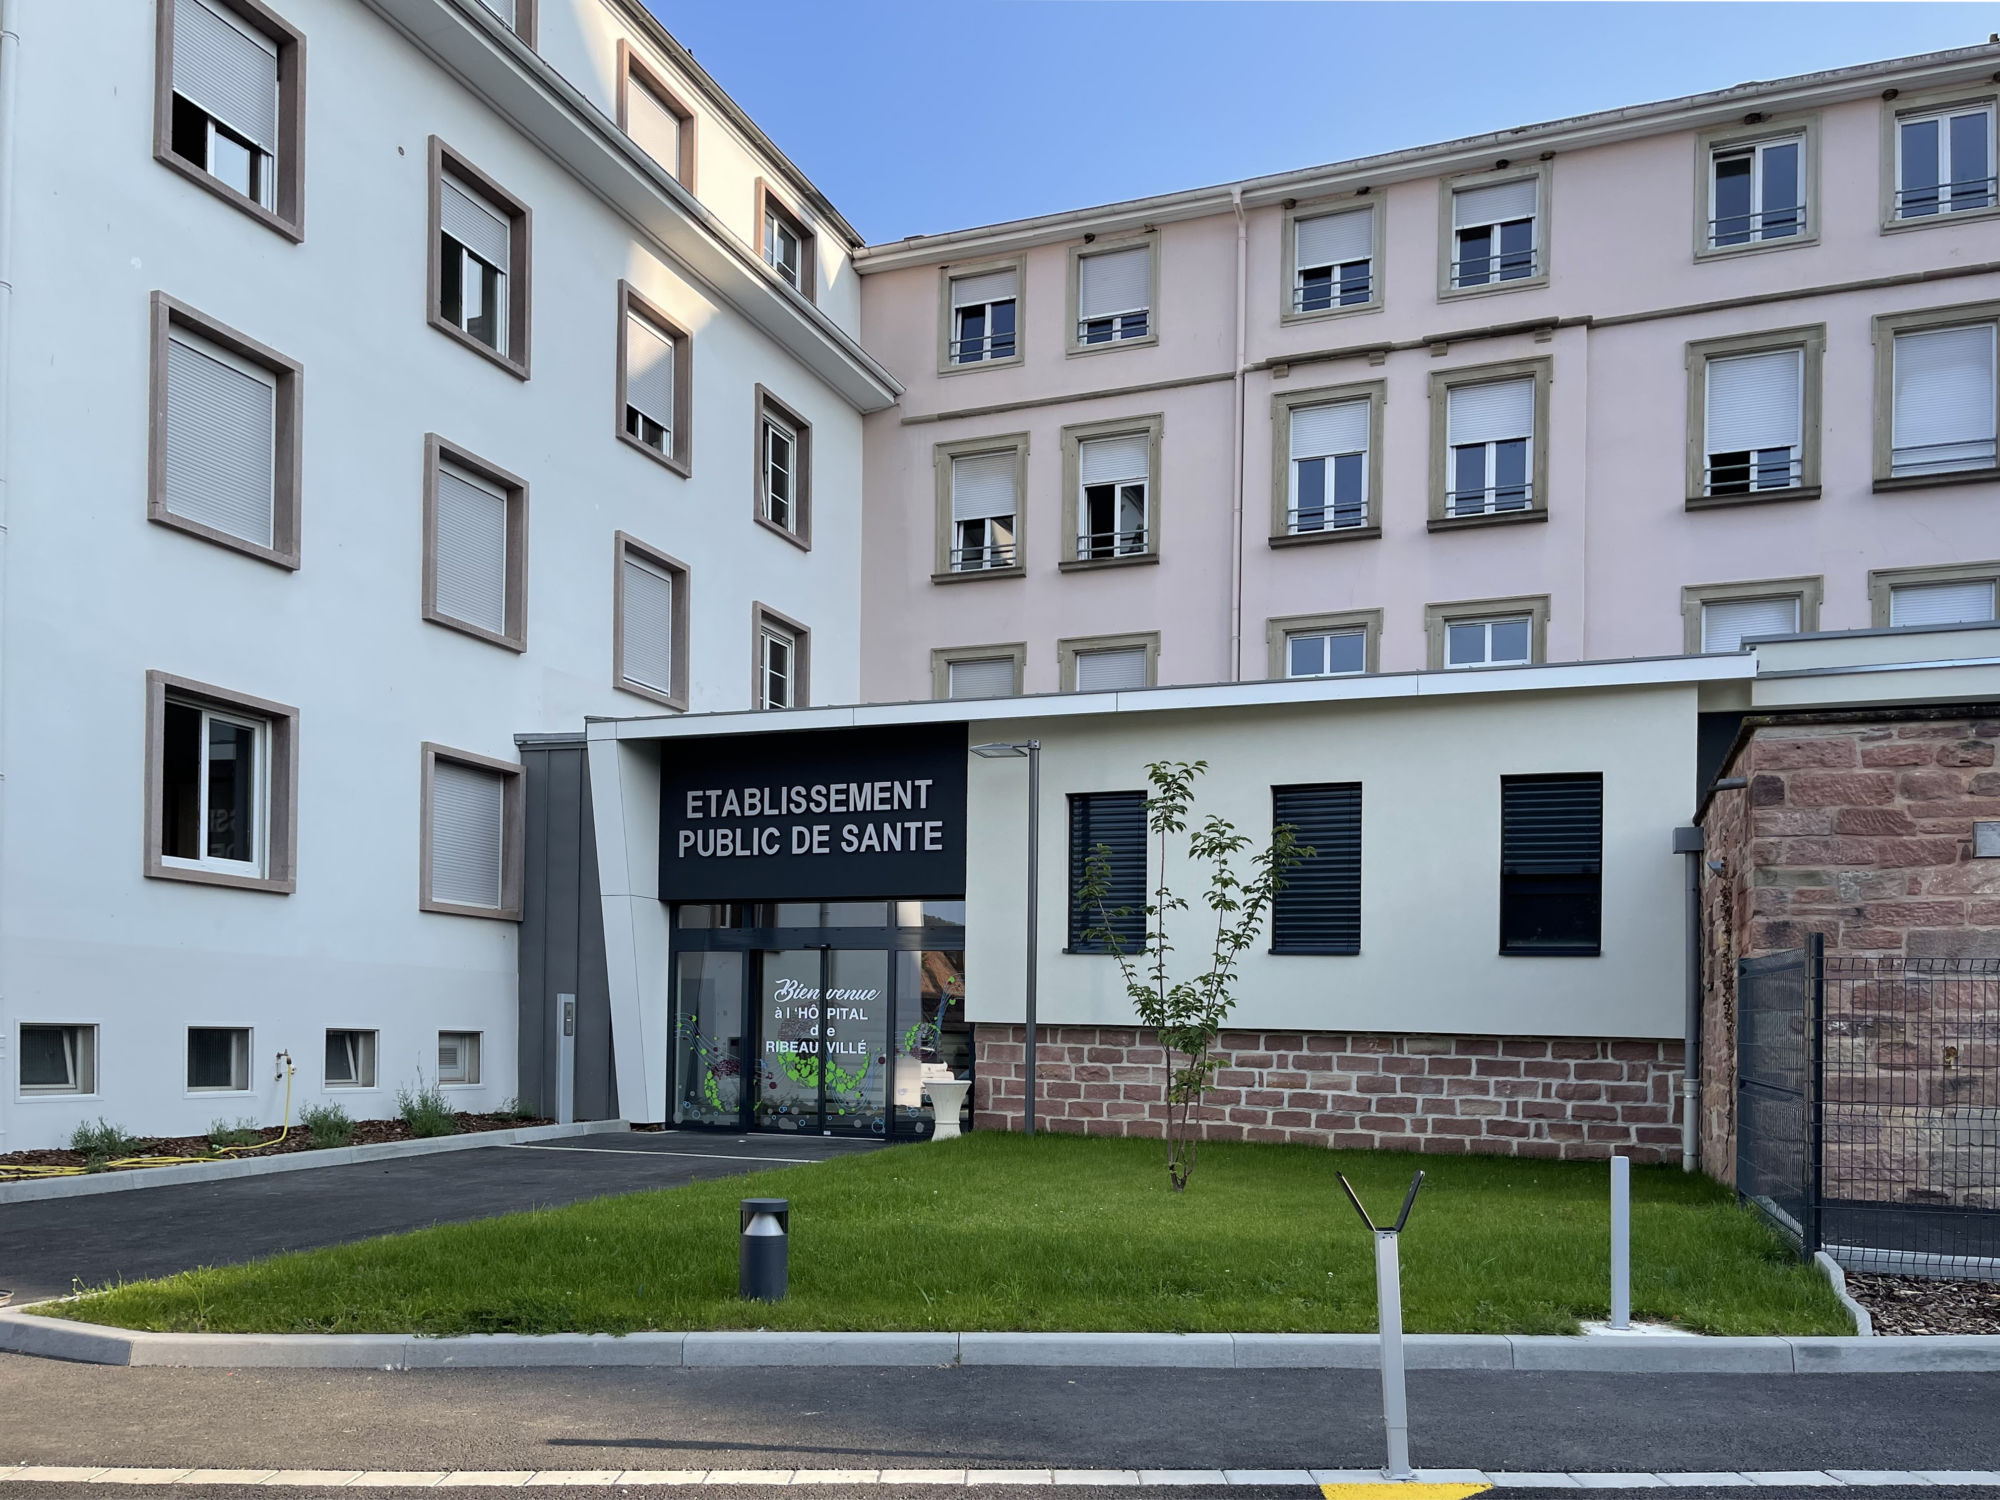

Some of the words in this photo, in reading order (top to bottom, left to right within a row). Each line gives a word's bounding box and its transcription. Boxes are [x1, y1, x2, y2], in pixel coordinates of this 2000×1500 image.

[686, 779, 933, 819] ETABLISSEMENT
[678, 827, 781, 858] PUBLIC
[791, 824, 830, 855] DE
[840, 820, 943, 852] SANTE
